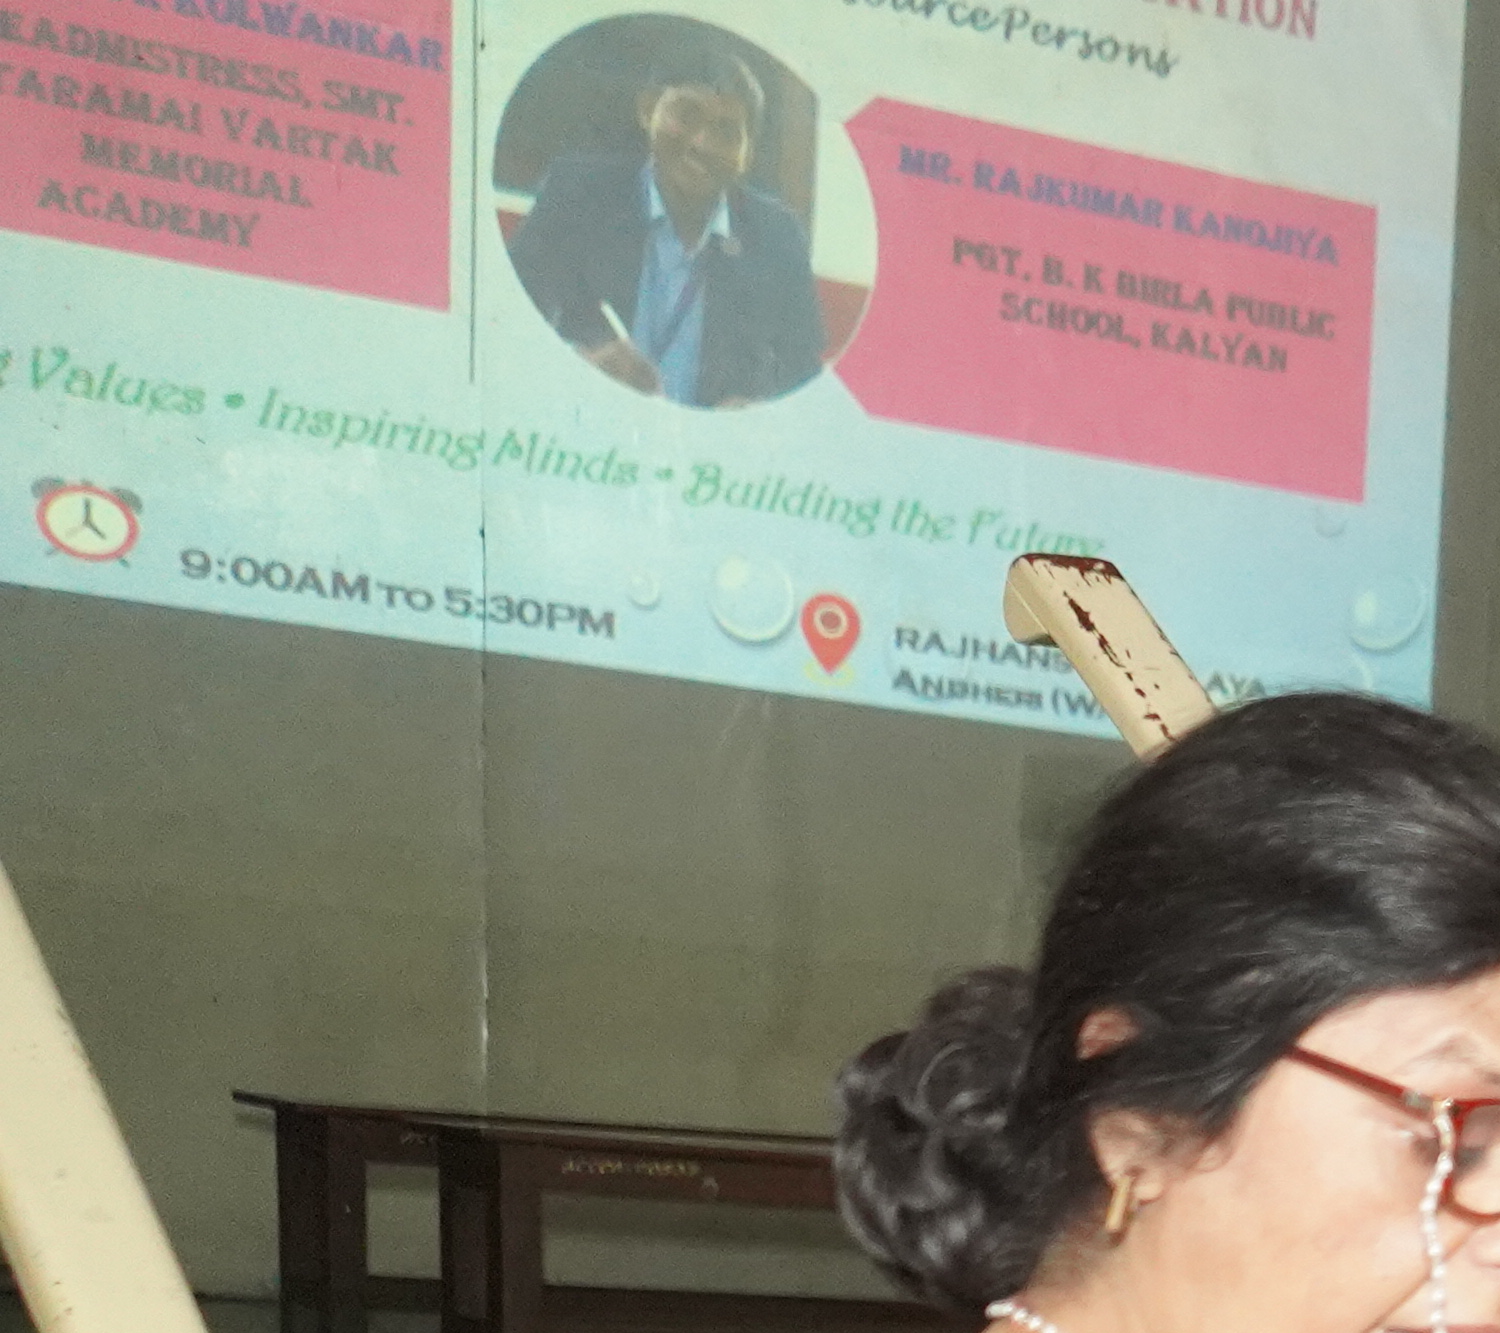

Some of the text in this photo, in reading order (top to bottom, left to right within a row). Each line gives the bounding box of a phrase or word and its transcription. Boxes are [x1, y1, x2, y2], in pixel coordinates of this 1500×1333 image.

[221, 106, 401, 176] VARTAK
[321, 79, 415, 126] SMT.
[80, 131, 313, 209] MEMORIAL
[898, 144, 1340, 267] MR. RAJKUMAR KANOJIYA
[37, 177, 260, 249] ACADEMY
[952, 236, 1337, 341] PGT. B. K BIRLA PUBLIC
[1000, 292, 1289, 374] SCHOOL, KALYAN
[30, 345, 207, 414] Values
[257, 386, 486, 472] Inspiring
[493, 428, 639, 486] Minds
[682, 463, 881, 539] Building
[890, 499, 956, 544] the
[180, 548, 617, 640] 9:00AM TO 5:30PM
[892, 668, 1044, 711] ANDHERI
